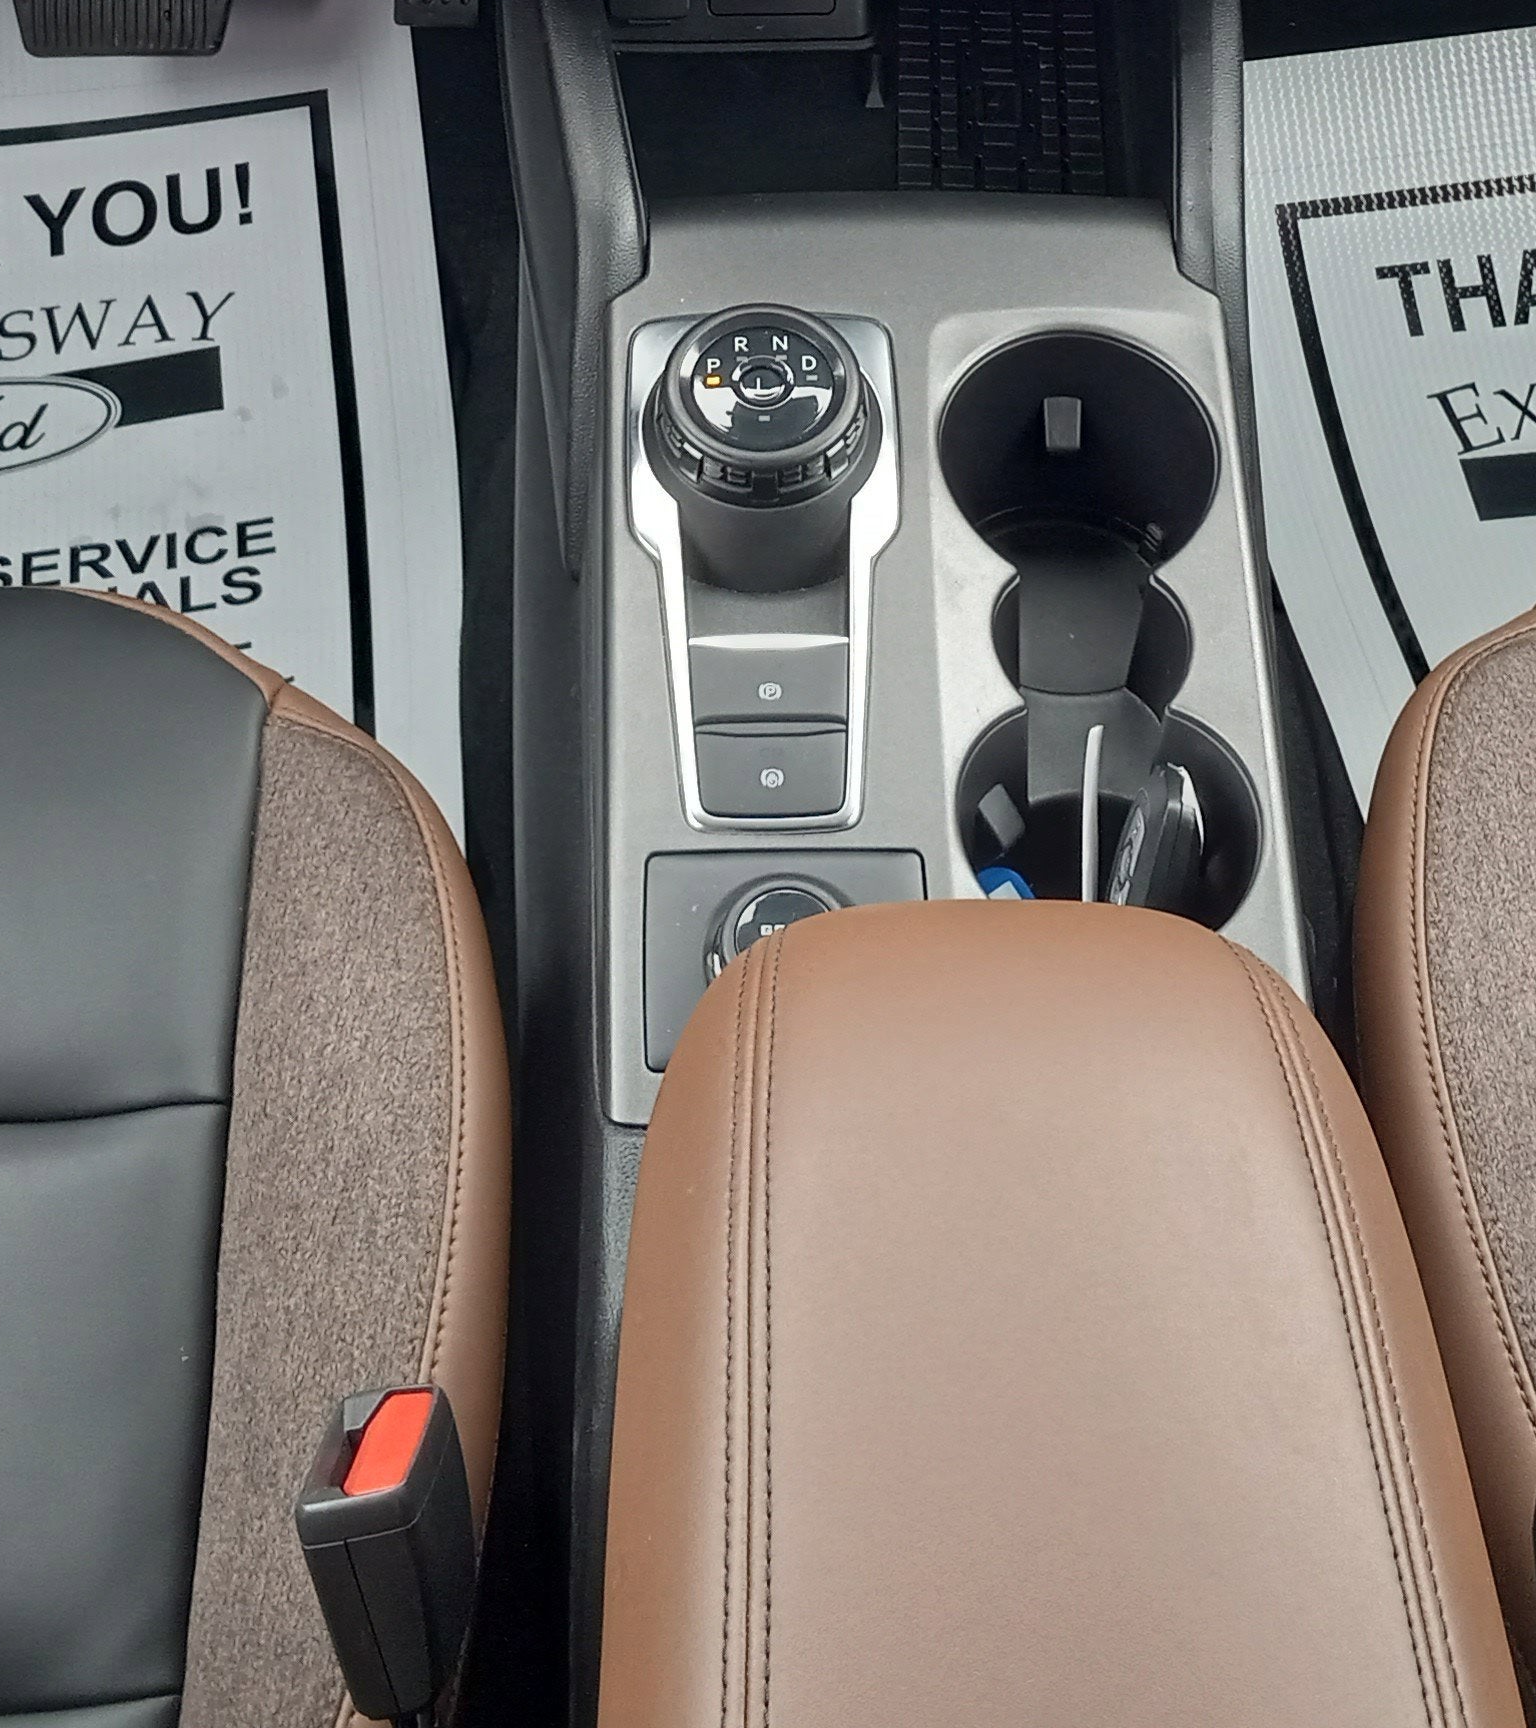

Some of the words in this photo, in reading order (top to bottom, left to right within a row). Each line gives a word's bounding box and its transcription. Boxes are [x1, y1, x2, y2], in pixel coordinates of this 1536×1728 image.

[23, 162, 255, 256] YOU!
[734, 336, 748, 351] R
[773, 335, 787, 351] N
[707, 358, 720, 373] P
[801, 356, 817, 371] D
